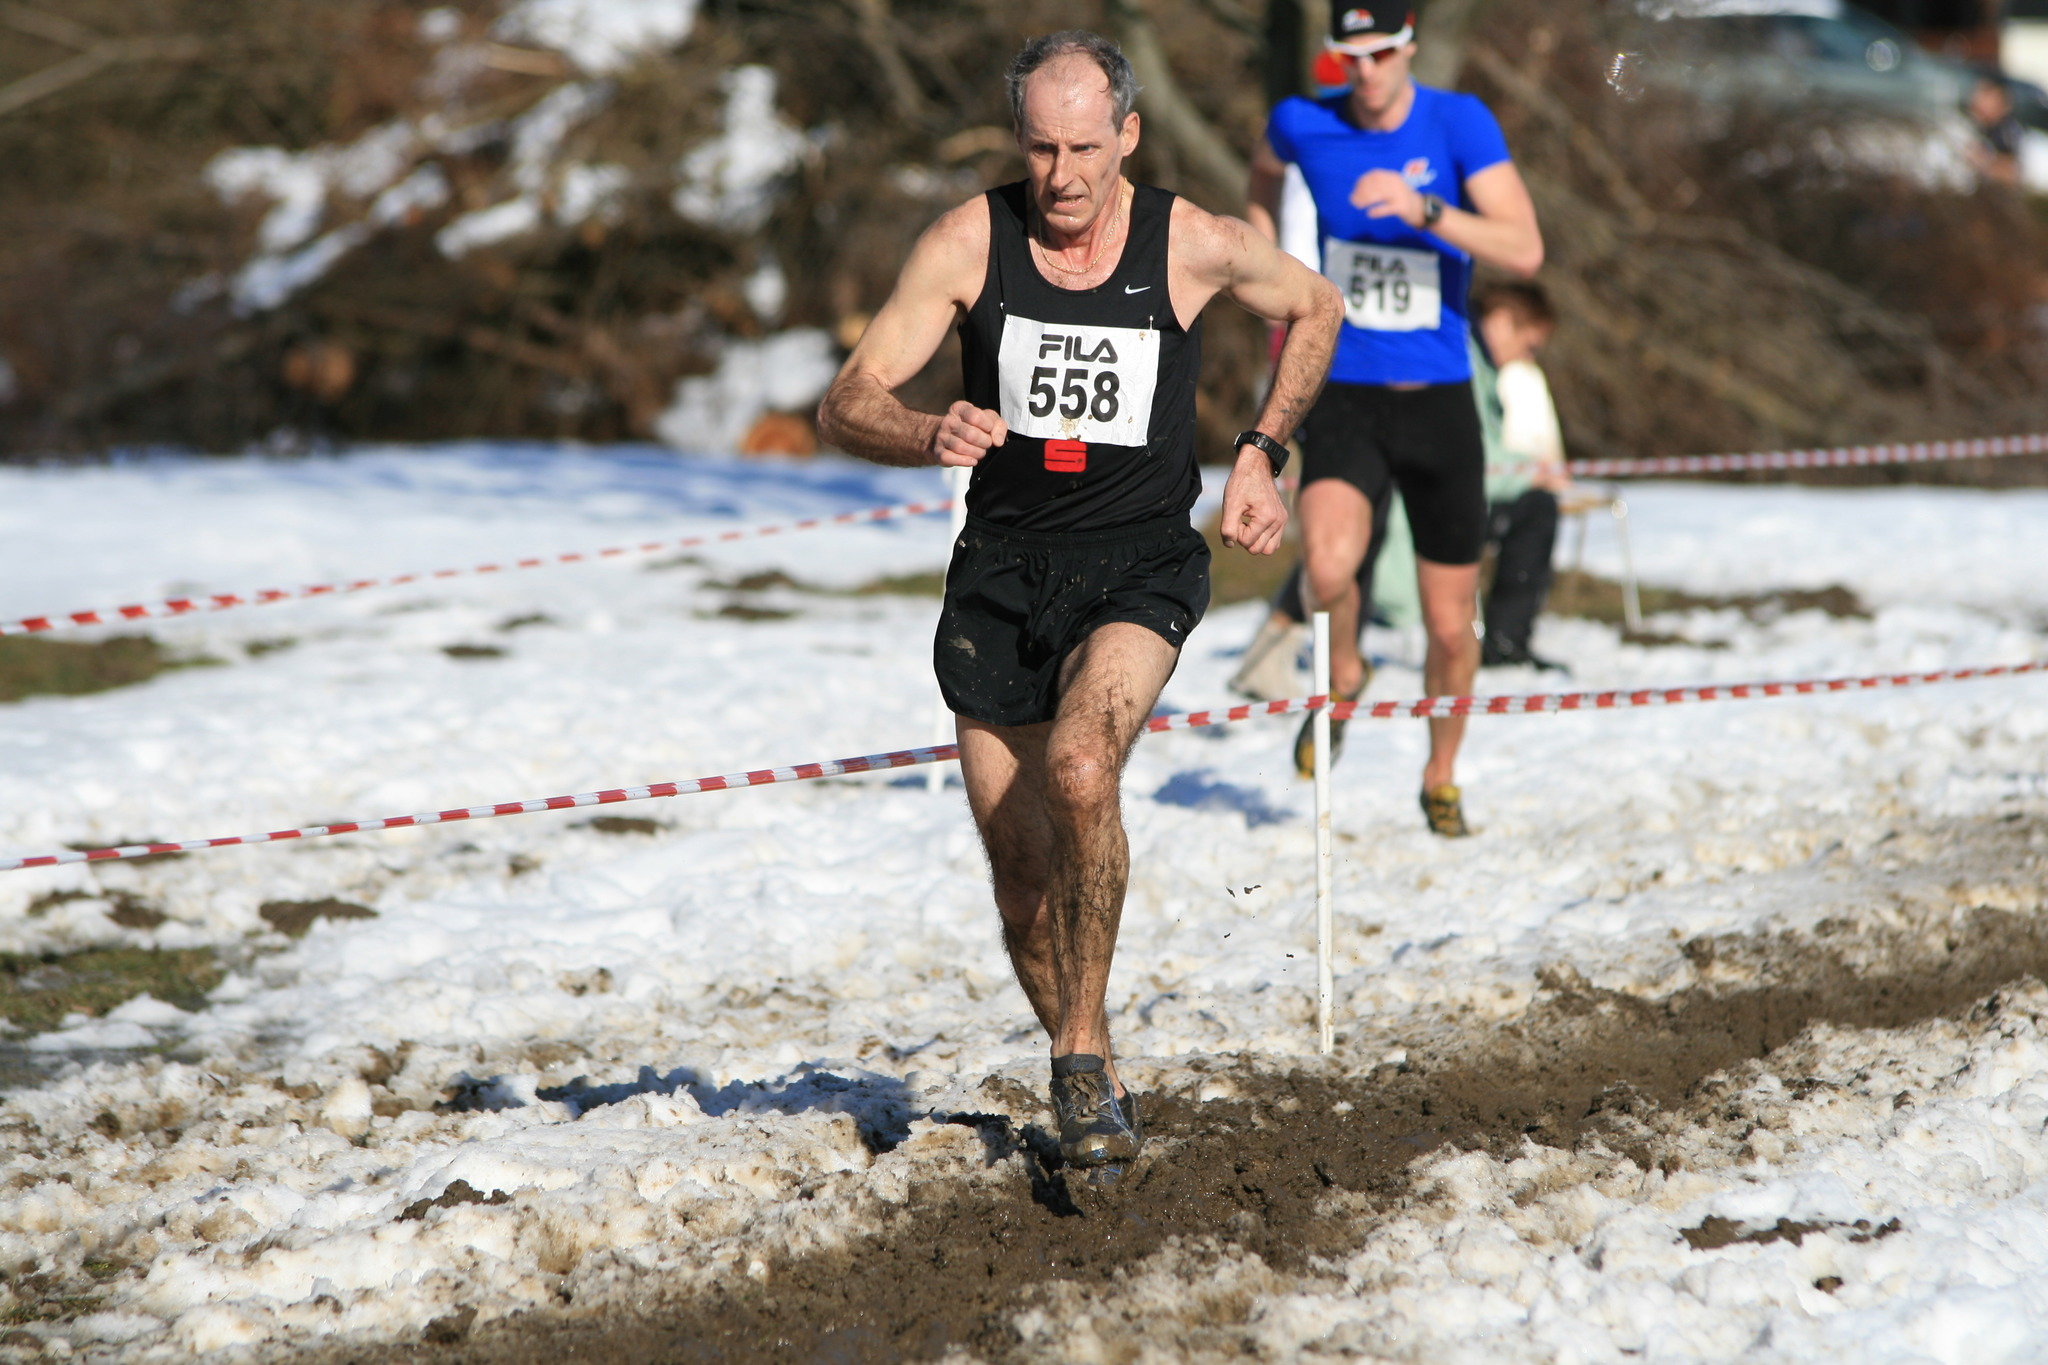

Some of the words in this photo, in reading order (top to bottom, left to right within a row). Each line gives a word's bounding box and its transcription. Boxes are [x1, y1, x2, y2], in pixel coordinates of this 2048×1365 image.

[1352, 253, 1406, 275] FILA
[1038, 334, 1119, 364] FILA
[1028, 366, 1120, 423] 558
